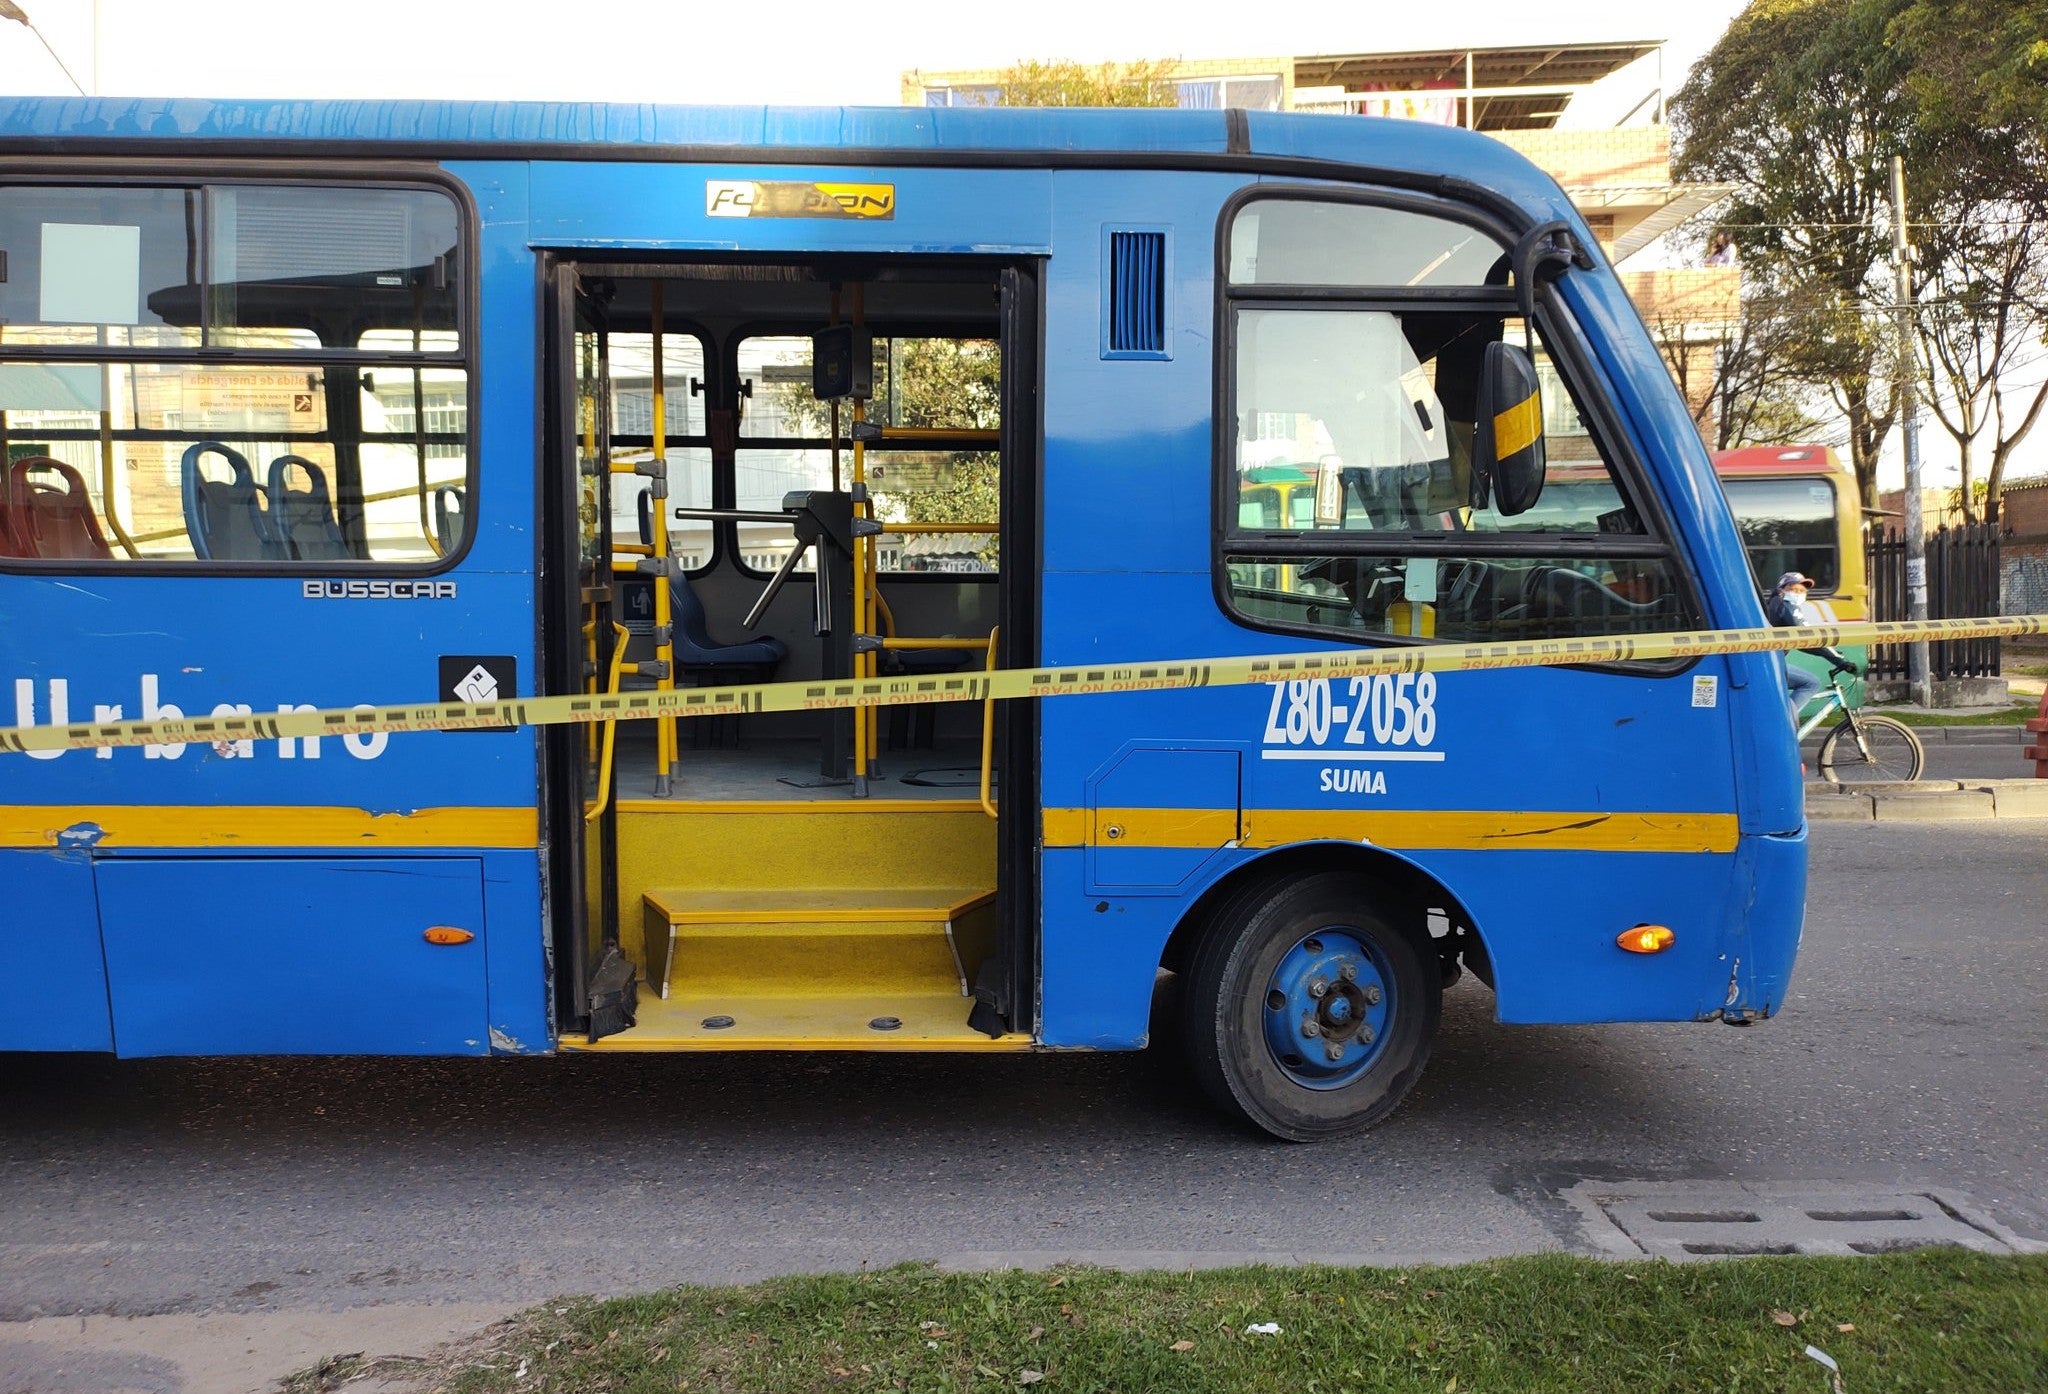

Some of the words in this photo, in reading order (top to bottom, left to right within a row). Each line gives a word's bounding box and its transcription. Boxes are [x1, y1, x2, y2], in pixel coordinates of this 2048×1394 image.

[303, 580, 457, 599] BUSSCAR
[15, 674, 388, 759] Urbano
[1263, 672, 1437, 747] Z80-2058
[1320, 768, 1387, 795] SUMA
